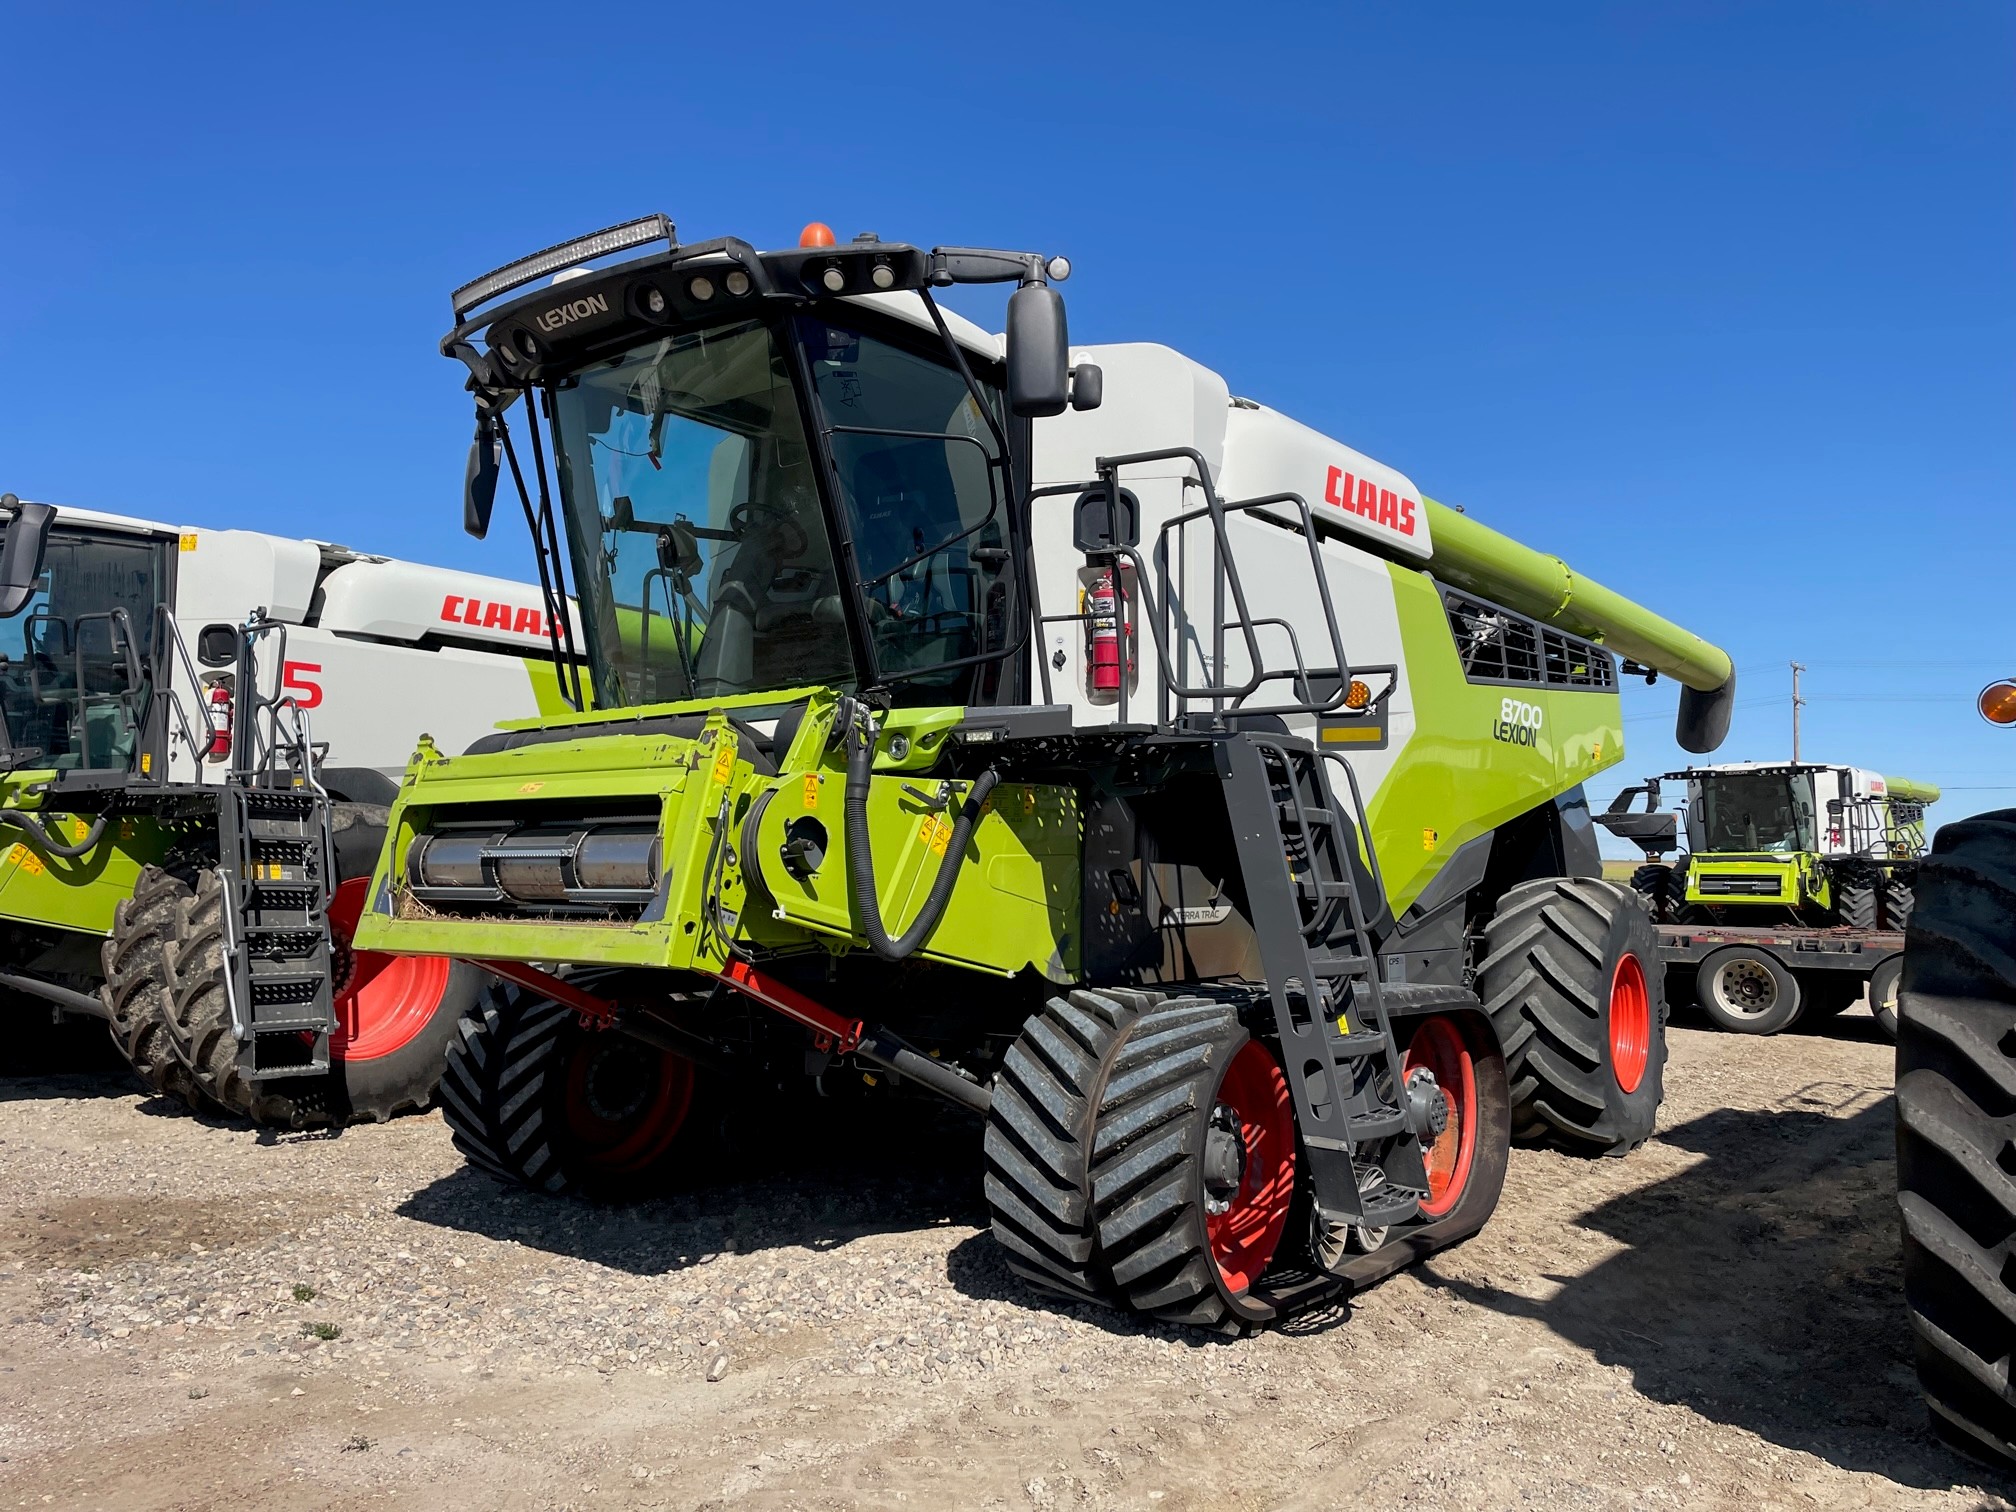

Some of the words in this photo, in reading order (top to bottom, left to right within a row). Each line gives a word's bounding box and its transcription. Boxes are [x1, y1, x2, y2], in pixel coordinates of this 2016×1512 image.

[536, 293, 609, 332] LEXION
[1325, 465, 1415, 536] CLAAS
[282, 660, 323, 709] 5
[1501, 697, 1543, 730] 8700
[1493, 719, 1537, 748] LEXION
[1177, 910, 1200, 920] TERRA
[1201, 909, 1220, 919] TRAC
